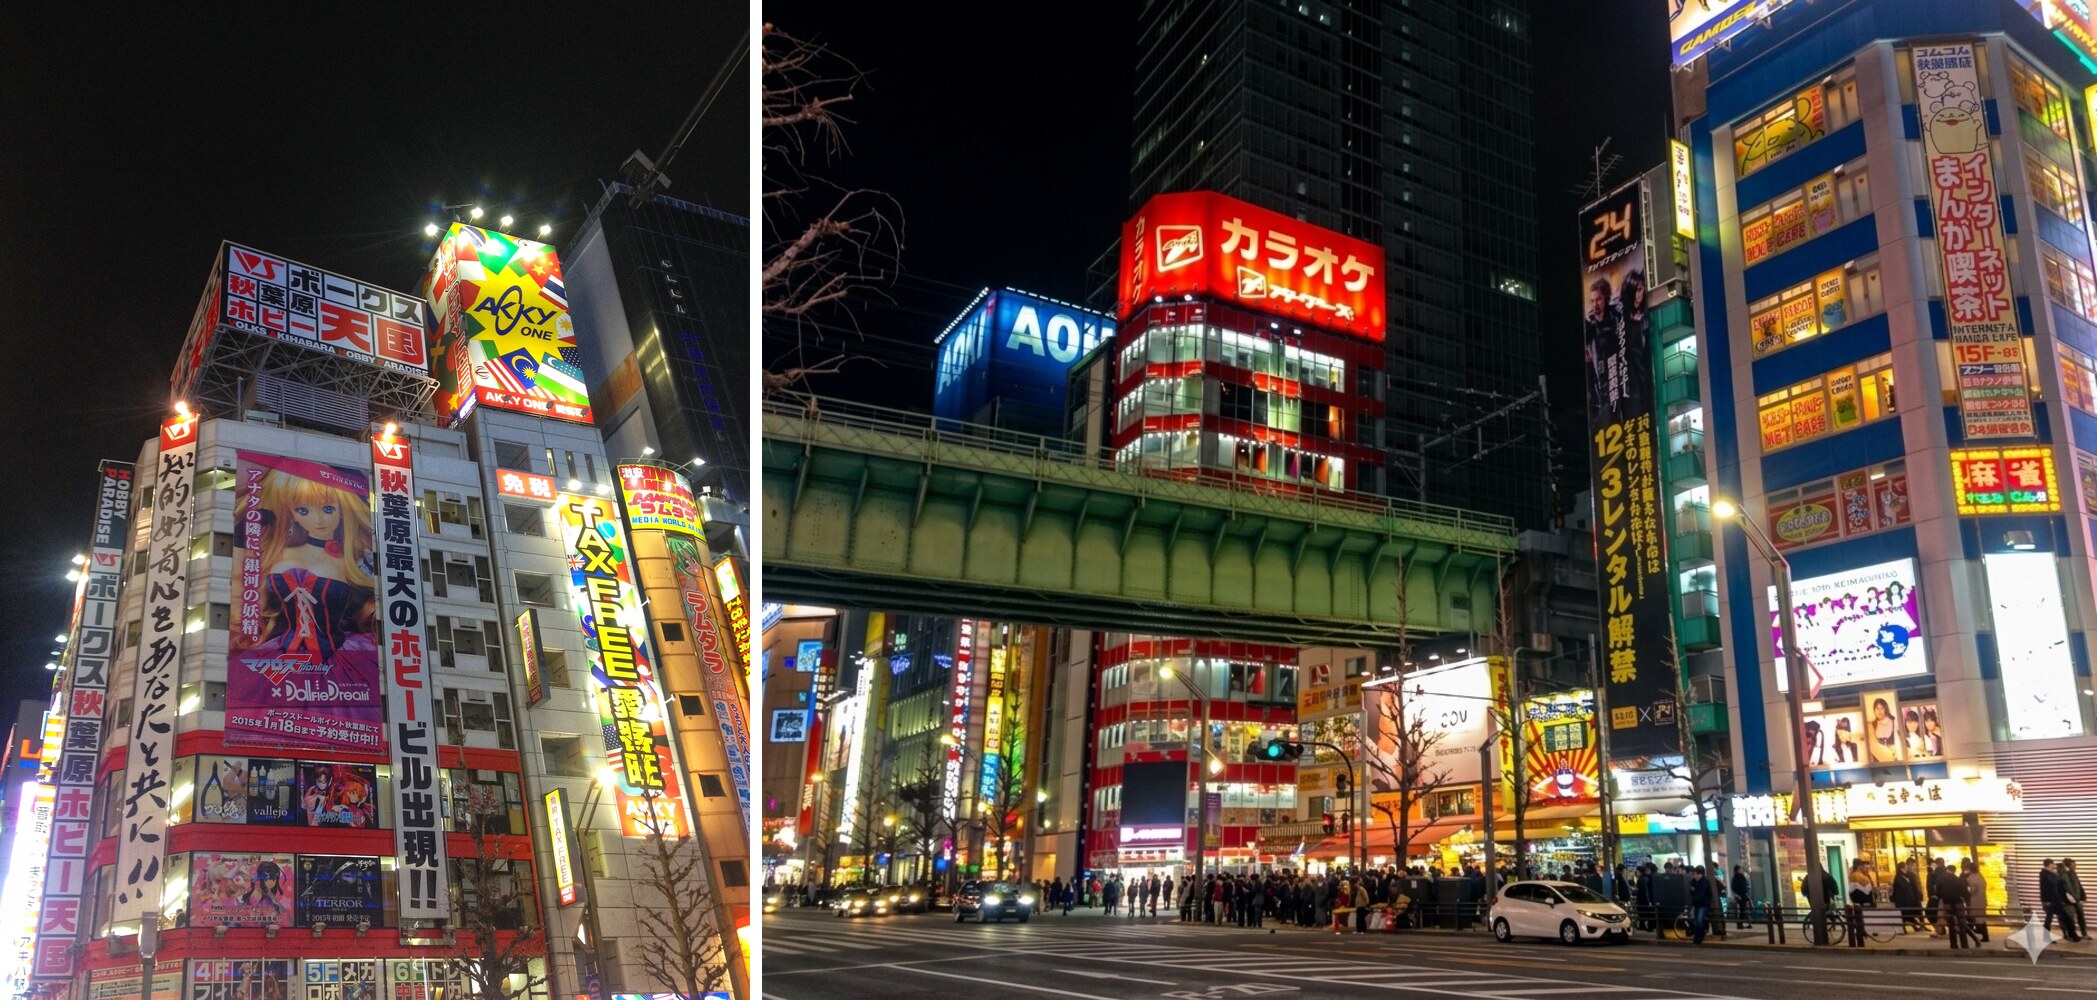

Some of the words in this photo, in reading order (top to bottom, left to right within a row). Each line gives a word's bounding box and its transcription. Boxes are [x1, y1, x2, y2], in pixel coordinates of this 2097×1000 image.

[1221, 217, 1375, 292] カラオケ
[1590, 203, 1632, 260] 24
[1934, 157, 1983, 321] まんが喫茶
[1966, 154, 2008, 320] インターネット
[228, 300, 315, 332] ホビー
[229, 275, 316, 316] 秋葉原
[290, 269, 423, 325] ボークス
[474, 296, 557, 326] AKKY
[227, 319, 267, 336] VOLKS
[269, 330, 335, 354] AKIHABARA
[338, 348, 376, 365] HOBBY
[377, 356, 429, 377] PARADISE
[320, 302, 425, 366] 天国
[521, 326, 554, 341] ONE
[95, 467, 117, 545] PARADISE
[115, 469, 132, 520] HOBBY
[502, 474, 552, 498] 免税
[641, 502, 695, 522] ラムタラ
[662, 518, 686, 528] WORLD
[242, 469, 264, 642] アナタの隣に、銀河の妖精。
[570, 504, 617, 576] TAX
[585, 577, 640, 682] FREE
[686, 591, 725, 674] ラムタラ
[240, 658, 298, 675] マクロス
[380, 469, 439, 909] 秋葉原最大のホビービル出現!!
[34, 574, 119, 977] ボークス秋葉原ホビー天国
[254, 805, 288, 817] vallejo
[626, 800, 677, 818] AKKY
[316, 899, 363, 908] TERROR
[196, 962, 231, 981] 4F
[308, 963, 338, 982] 5F
[343, 963, 375, 981] メカ
[396, 962, 425, 981] 6F
